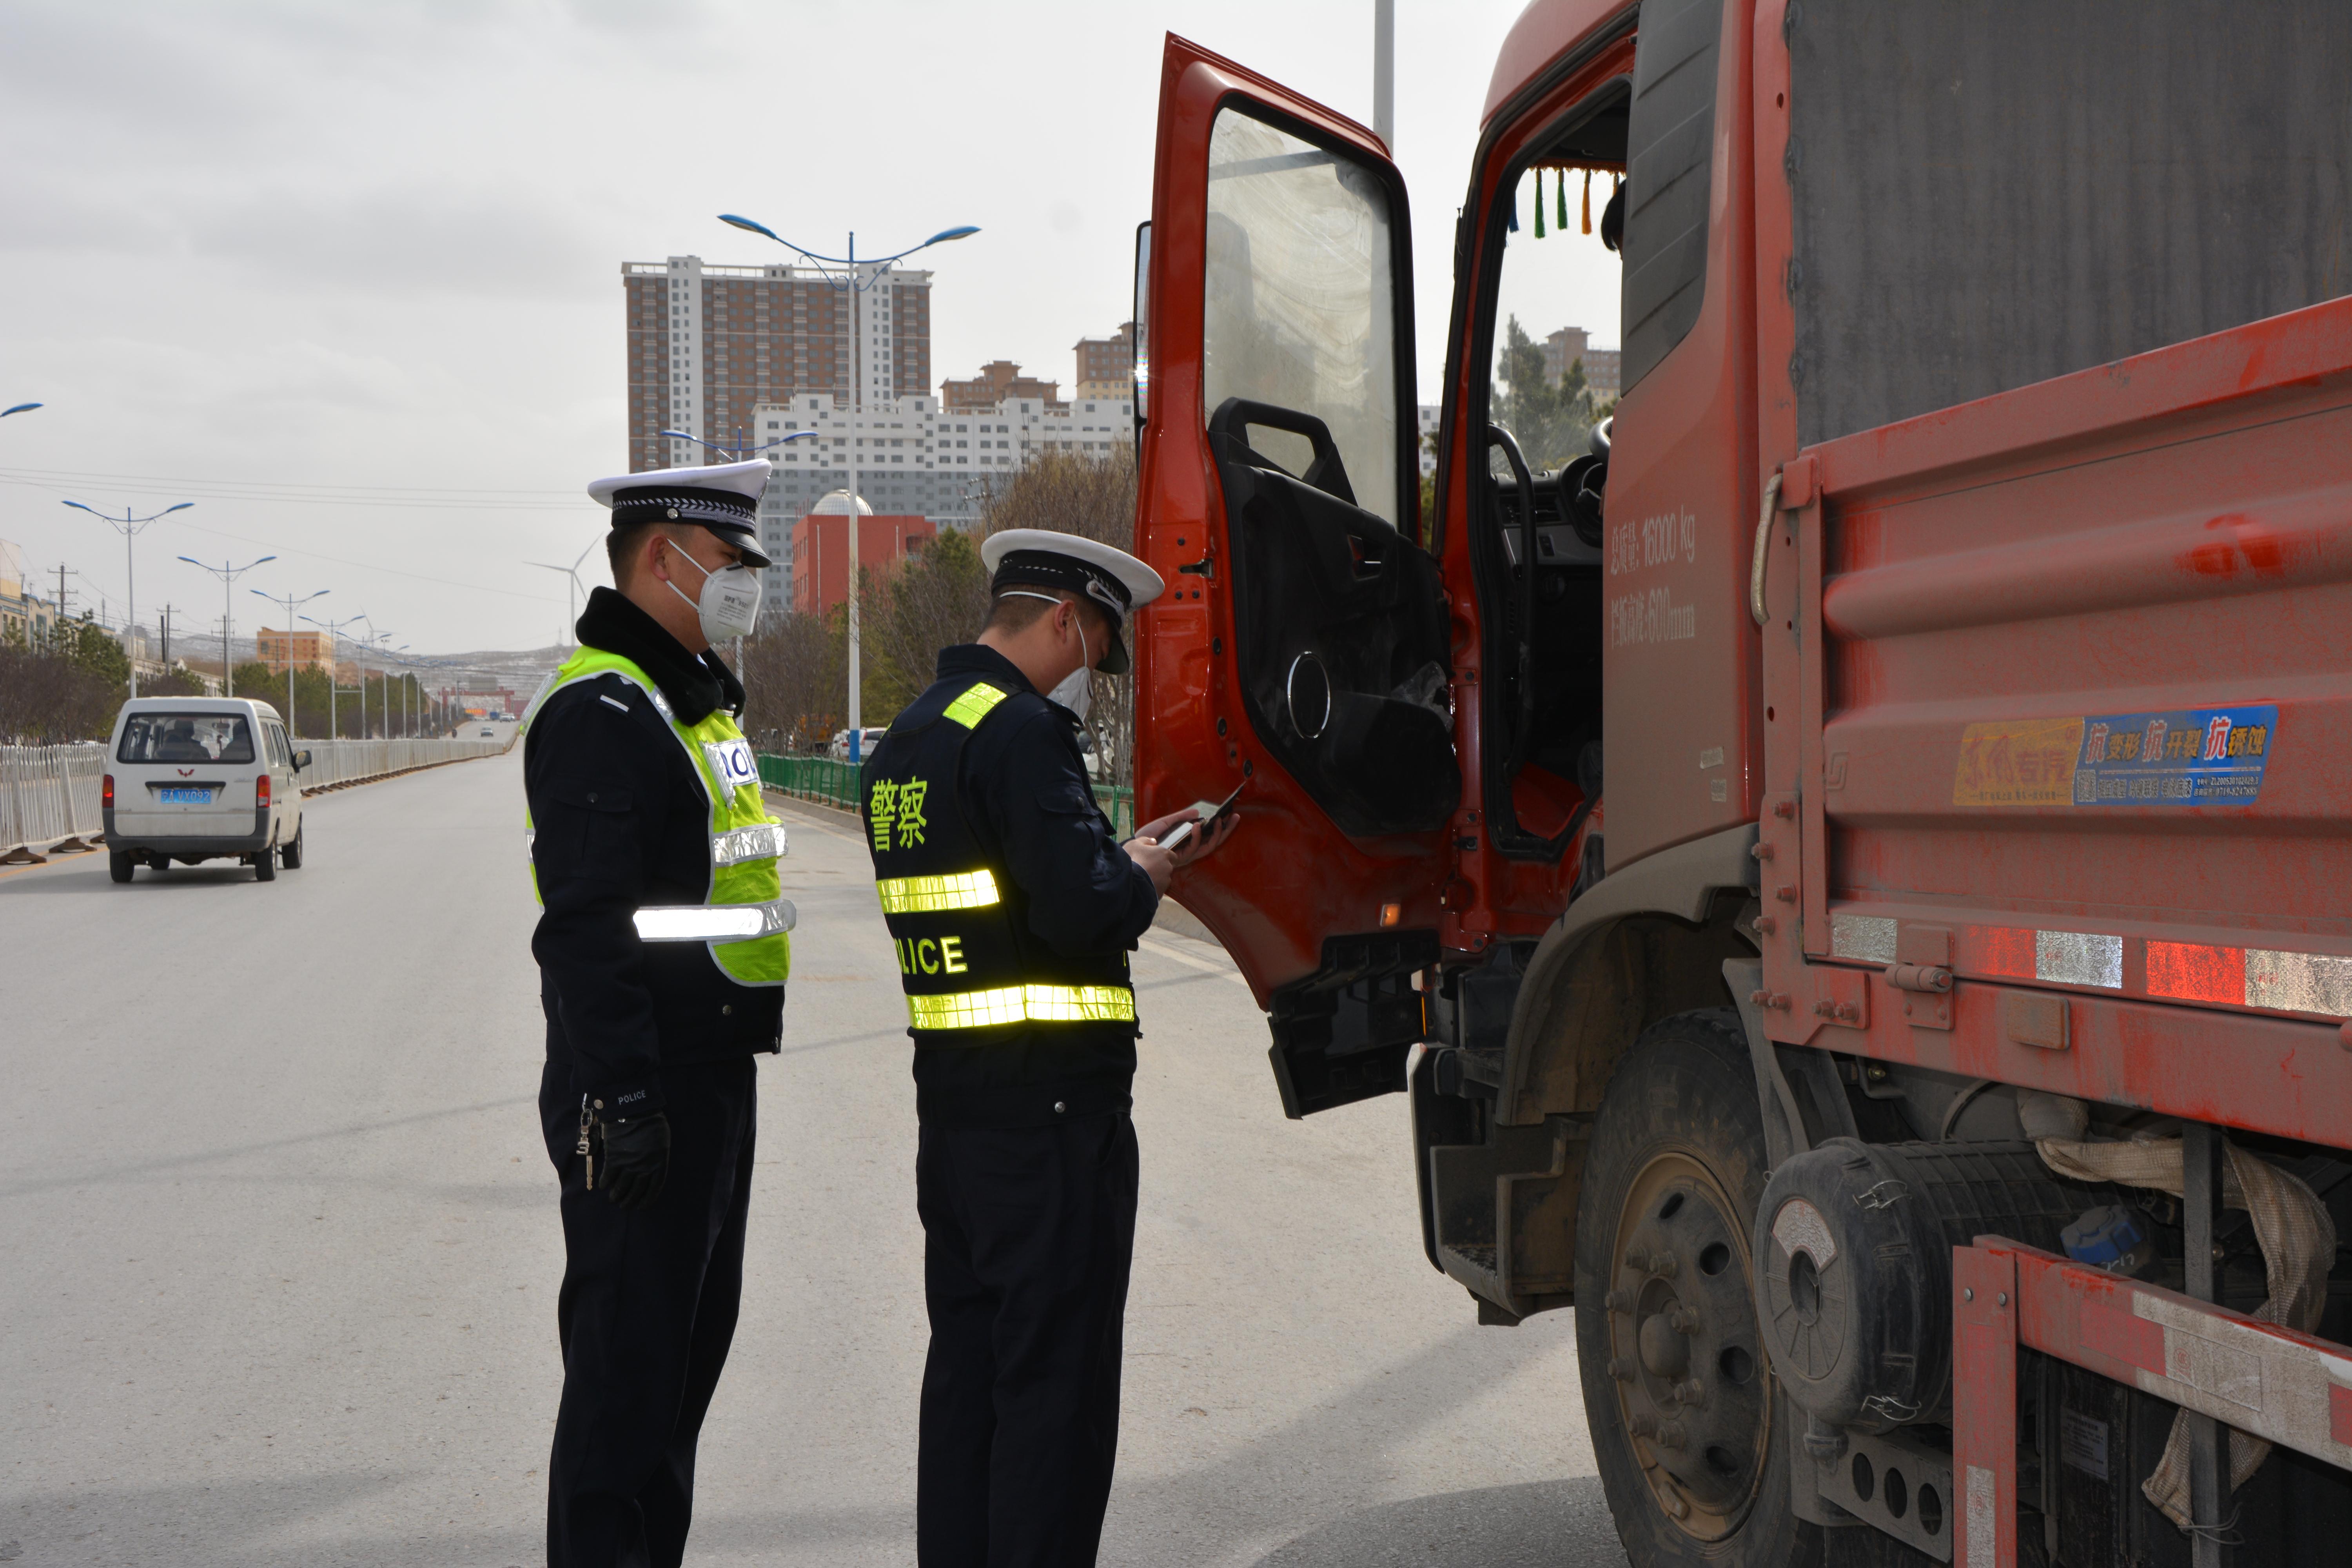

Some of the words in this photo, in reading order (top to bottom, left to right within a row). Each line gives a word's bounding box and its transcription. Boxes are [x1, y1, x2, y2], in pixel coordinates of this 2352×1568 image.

[1642, 513, 1677, 567] 16000
[1681, 505, 1695, 563] kg
[870, 775, 927, 853] 警察
[618, 1090, 646, 1105] POLICE
